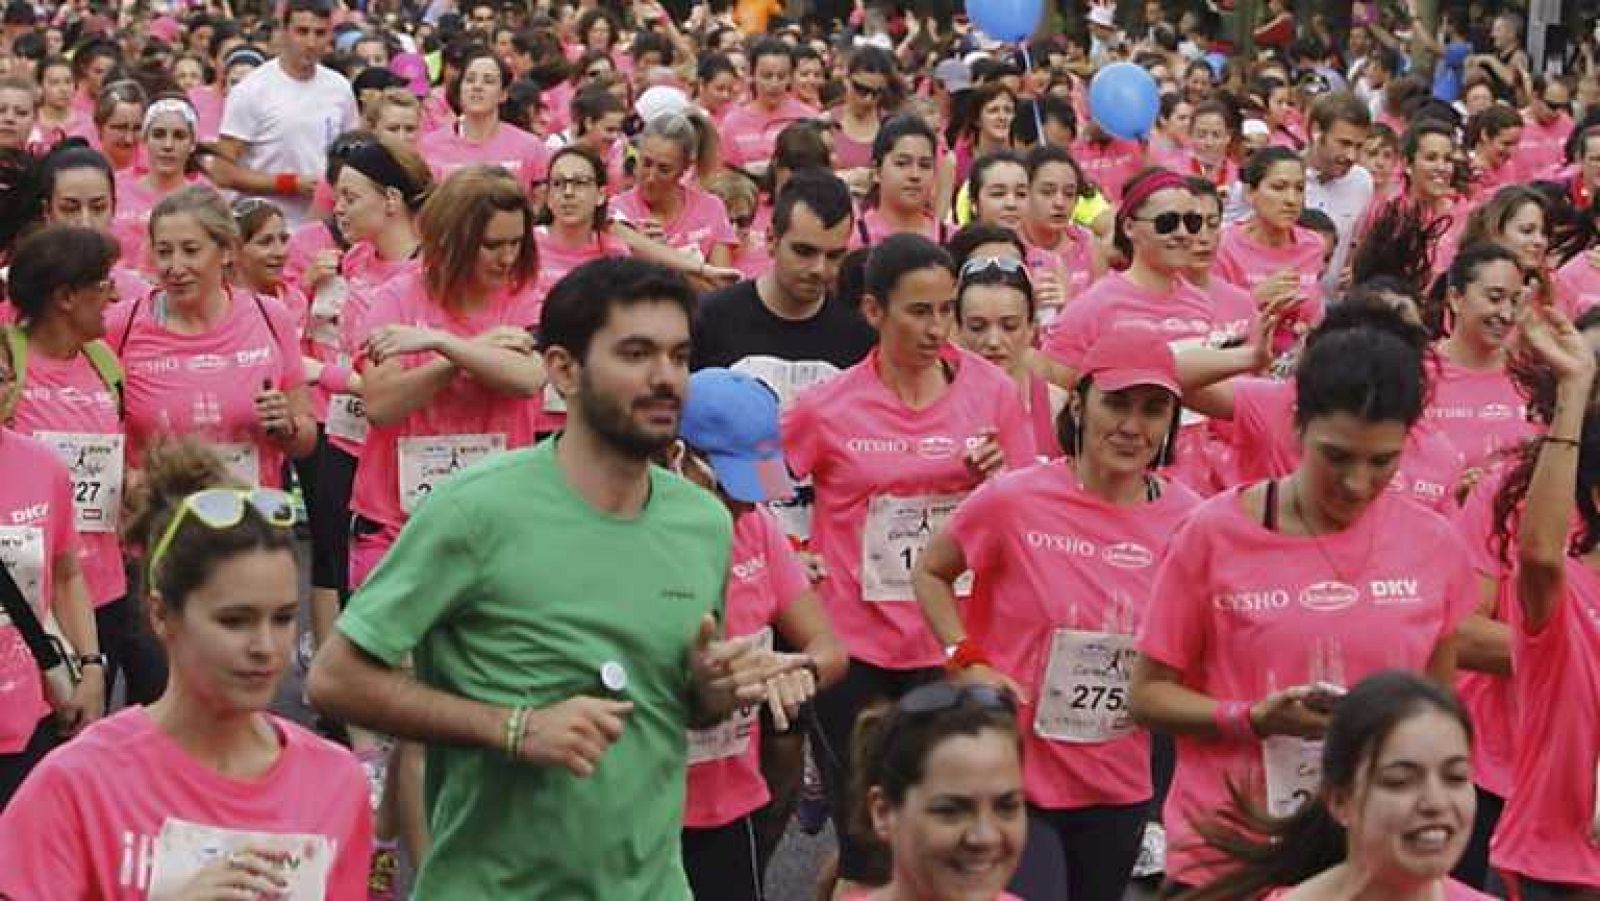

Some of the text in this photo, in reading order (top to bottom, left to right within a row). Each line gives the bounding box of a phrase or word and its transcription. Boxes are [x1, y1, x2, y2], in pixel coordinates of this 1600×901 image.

[236, 348, 270, 364] DKV
[847, 438, 907, 452] OYSHO
[12, 503, 49, 523] DKV
[1027, 531, 1095, 556] OYSHO
[1214, 589, 1290, 611] OYSHO
[1371, 578, 1418, 597] DKV
[1071, 684, 1129, 711] 275
